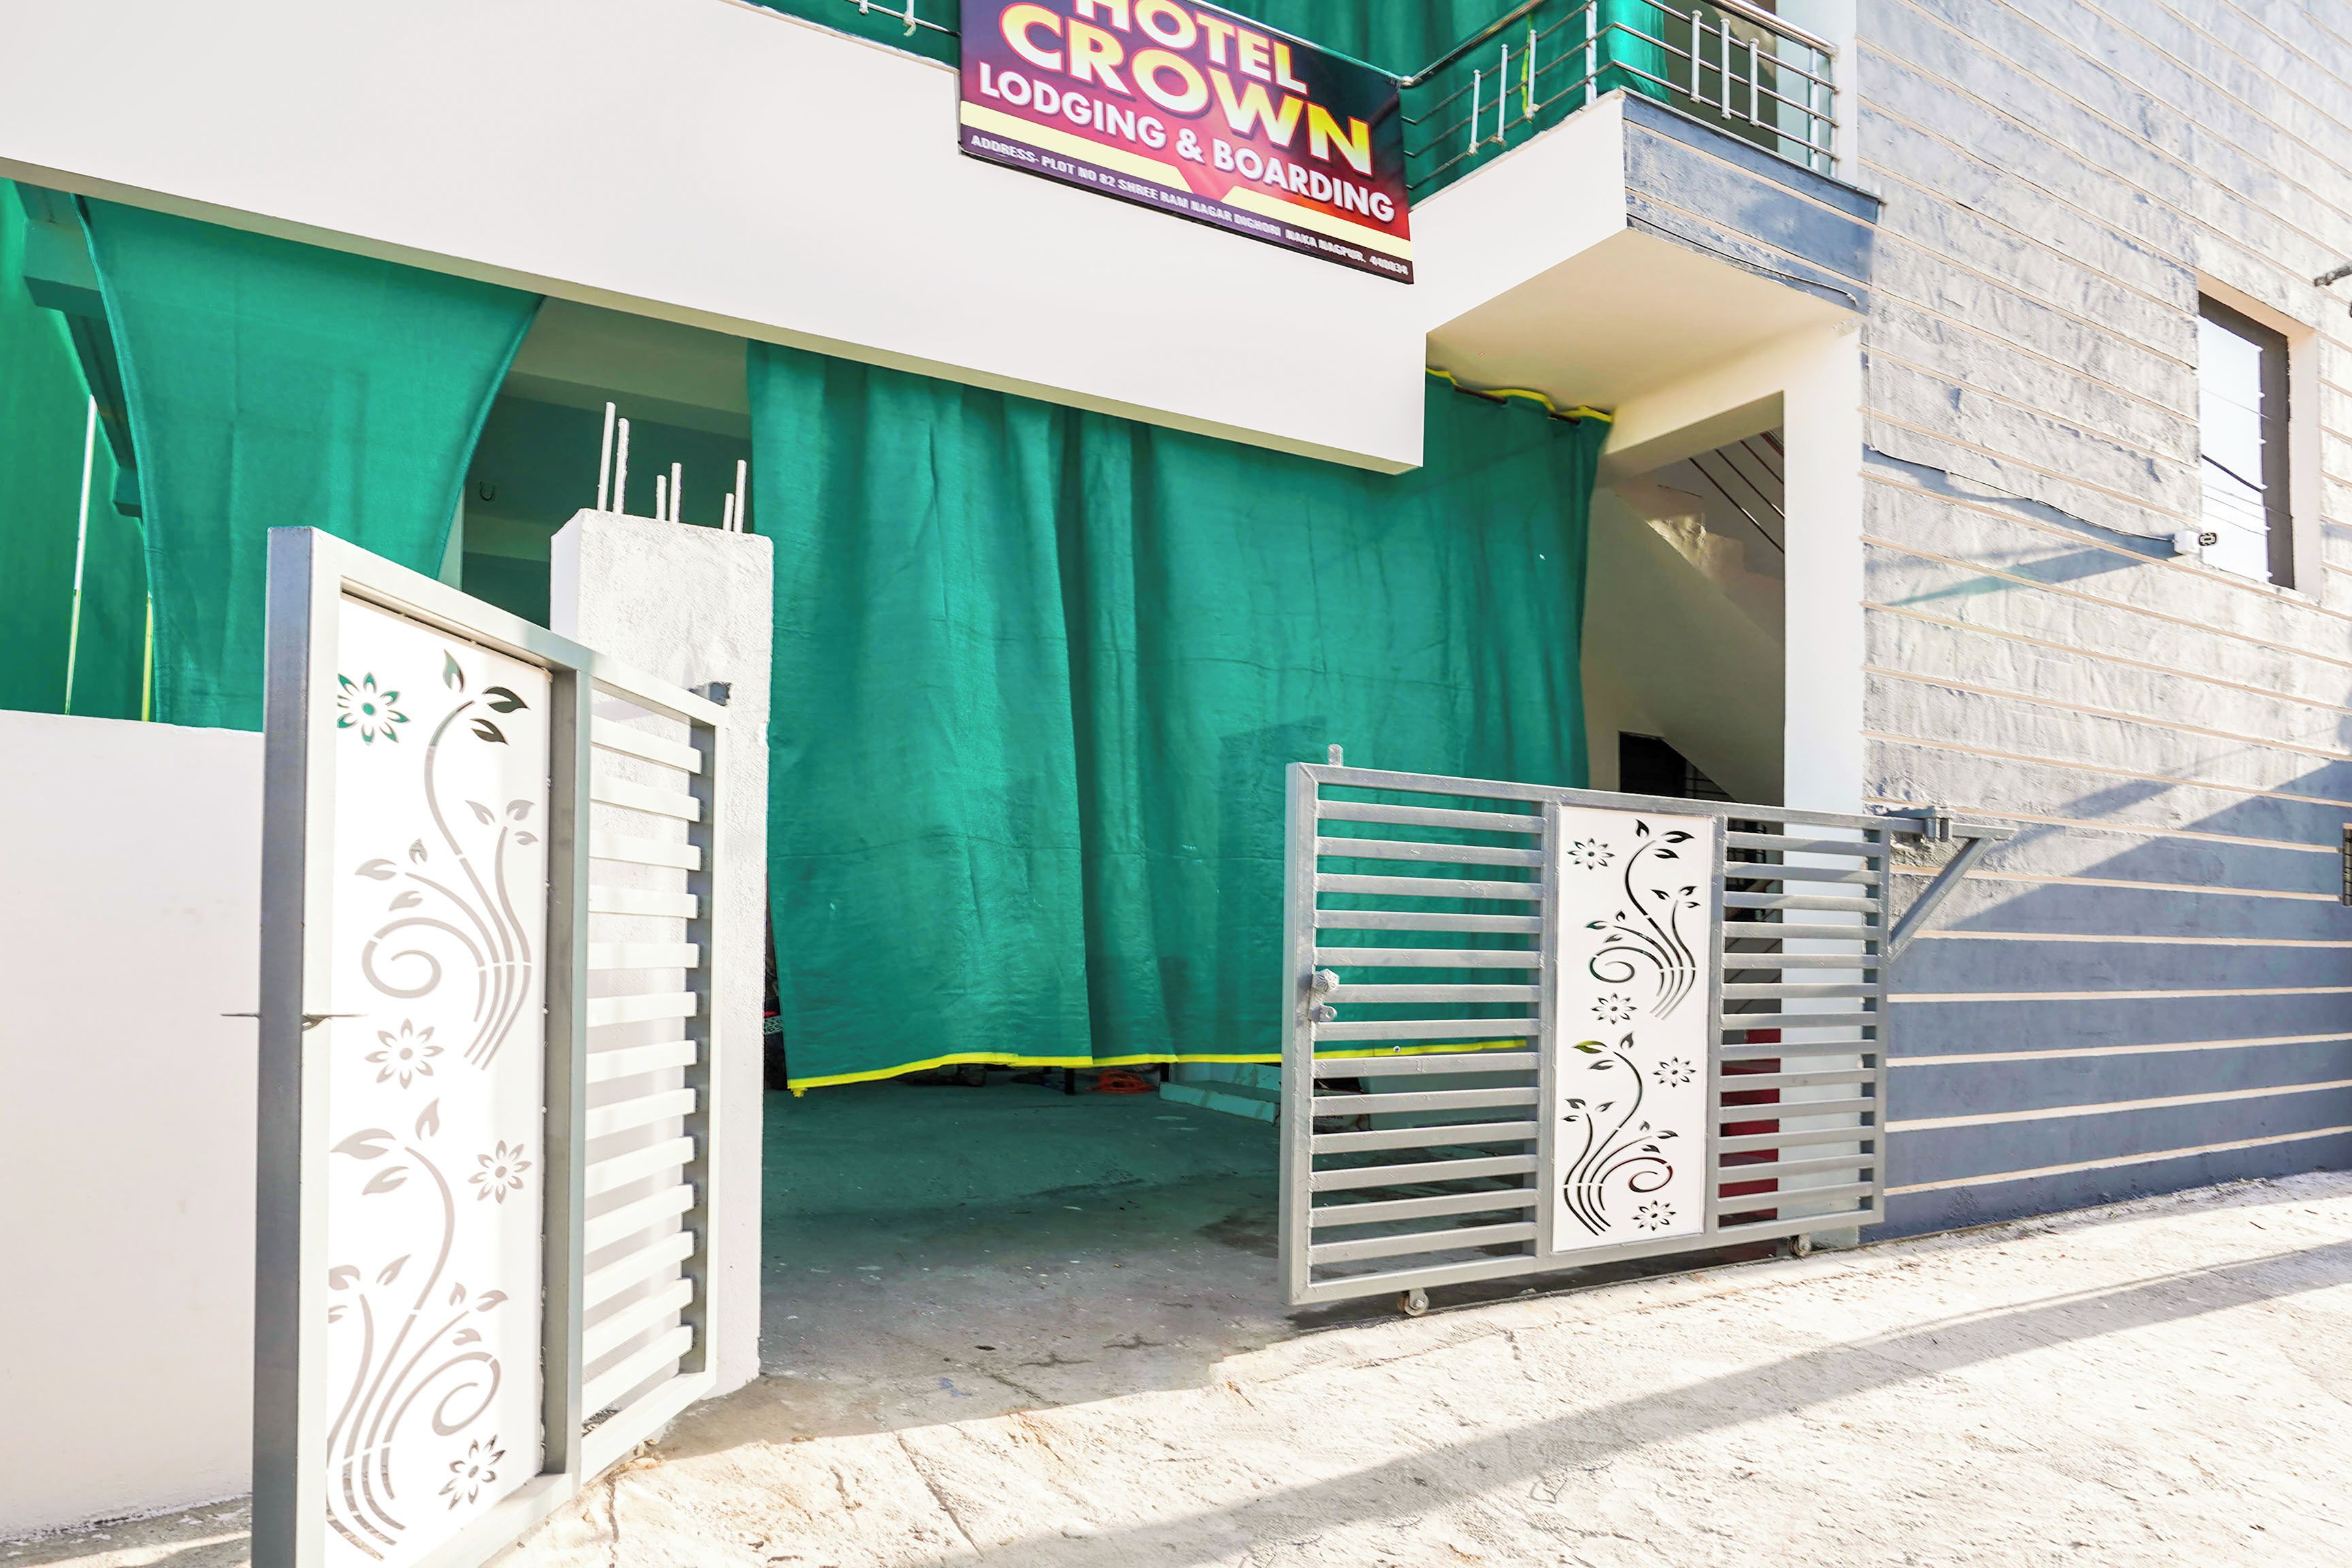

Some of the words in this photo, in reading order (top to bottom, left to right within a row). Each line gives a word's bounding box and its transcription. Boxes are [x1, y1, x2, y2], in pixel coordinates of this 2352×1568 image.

[979, 60, 1166, 149] LODGING
[1175, 128, 1205, 164] &
[1212, 137, 1395, 223] BOARDING
[999, 2, 1372, 176] CROWN
[1041, 155, 1075, 175] PLOT
[1078, 166, 1098, 182] NO
[1099, 172, 1116, 187] 82
[1117, 179, 1159, 200] SHREE
[1160, 191, 1189, 209] RAM
[1190, 200, 1232, 222] NAGAR
[1285, 229, 1318, 248] NAKA
